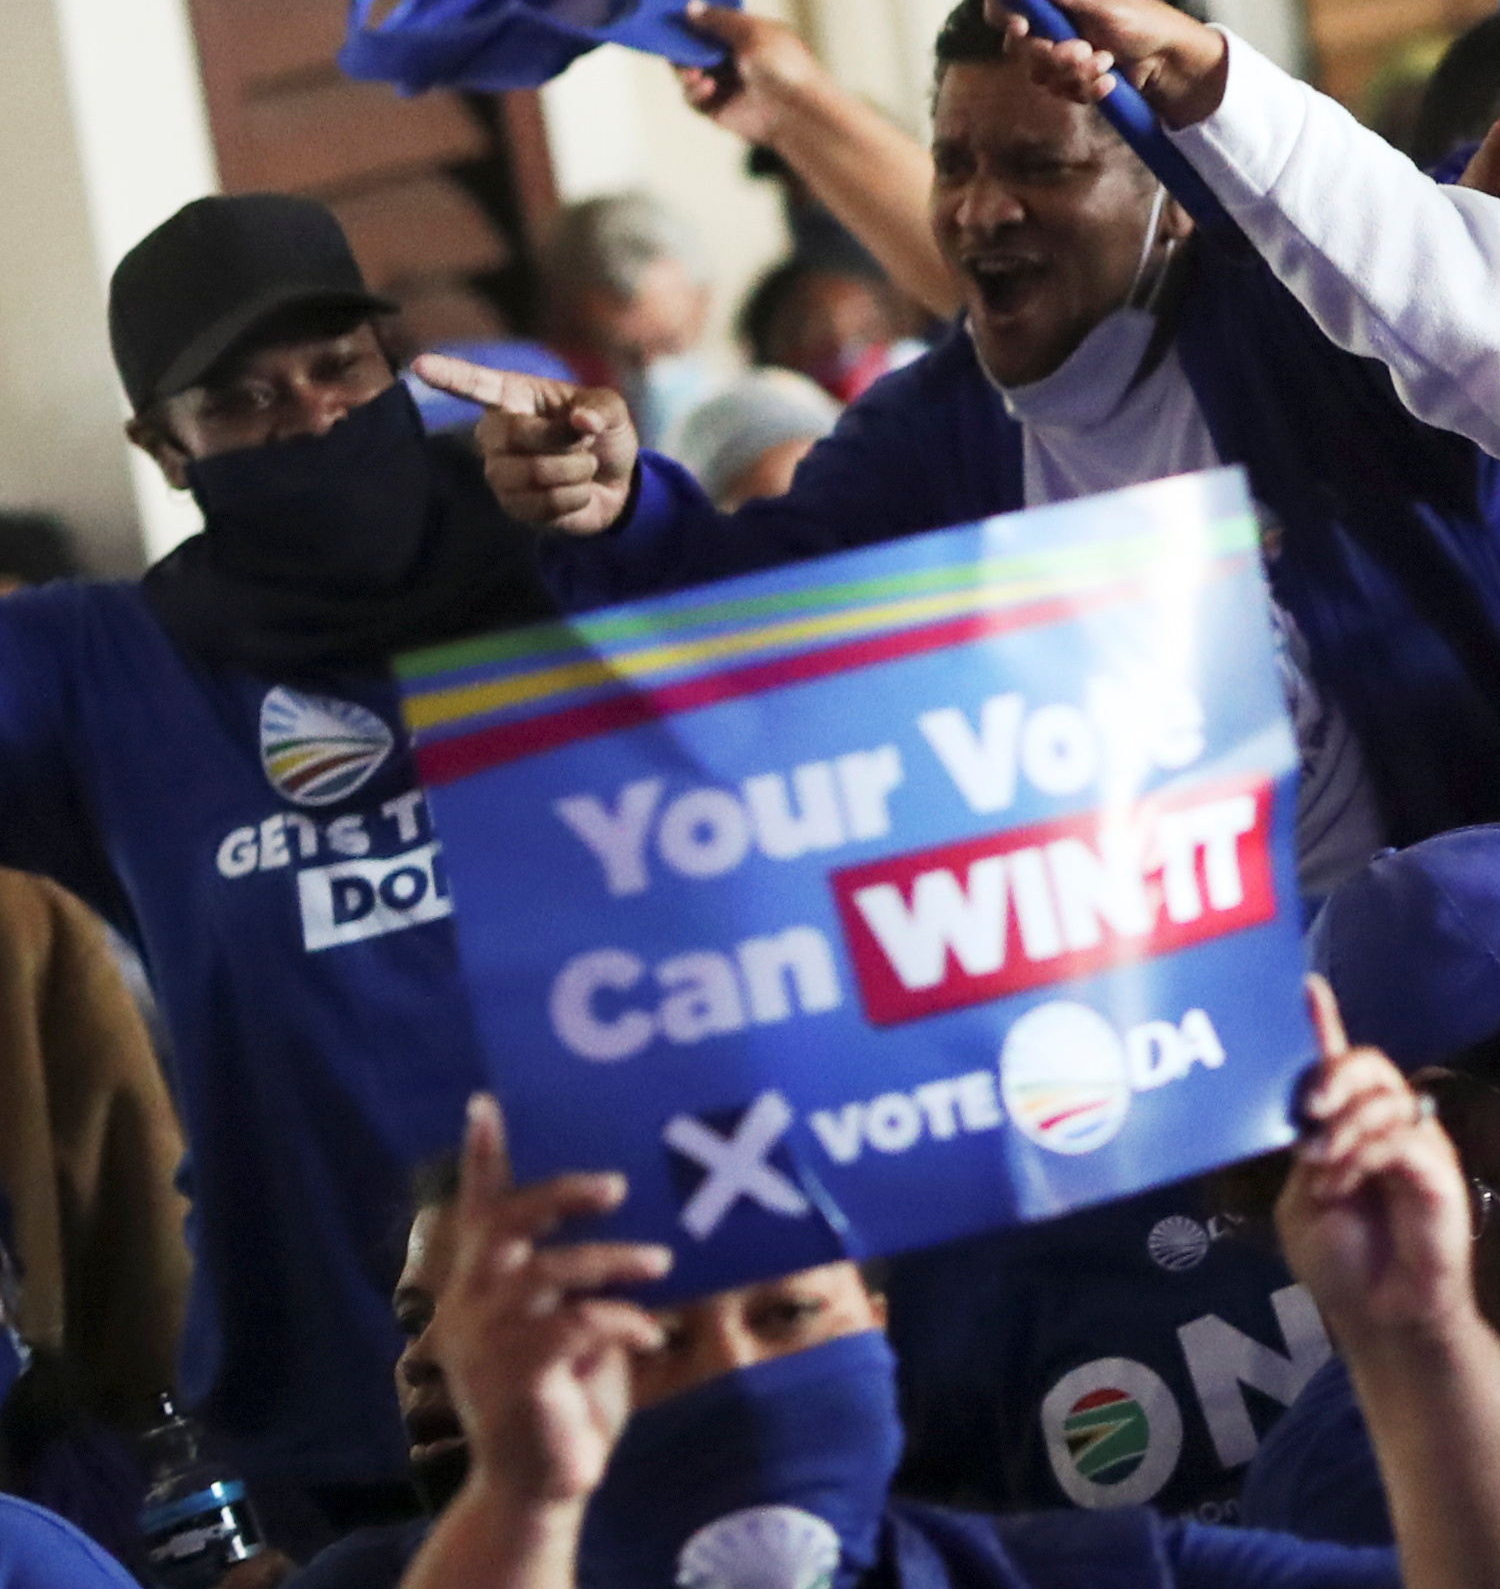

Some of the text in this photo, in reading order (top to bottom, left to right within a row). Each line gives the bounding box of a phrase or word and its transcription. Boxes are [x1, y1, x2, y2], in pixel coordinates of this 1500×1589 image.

[553, 666, 1203, 899] Your Vote
[550, 923, 843, 1063] Can
[809, 1008, 1226, 1164] VOTE DA
